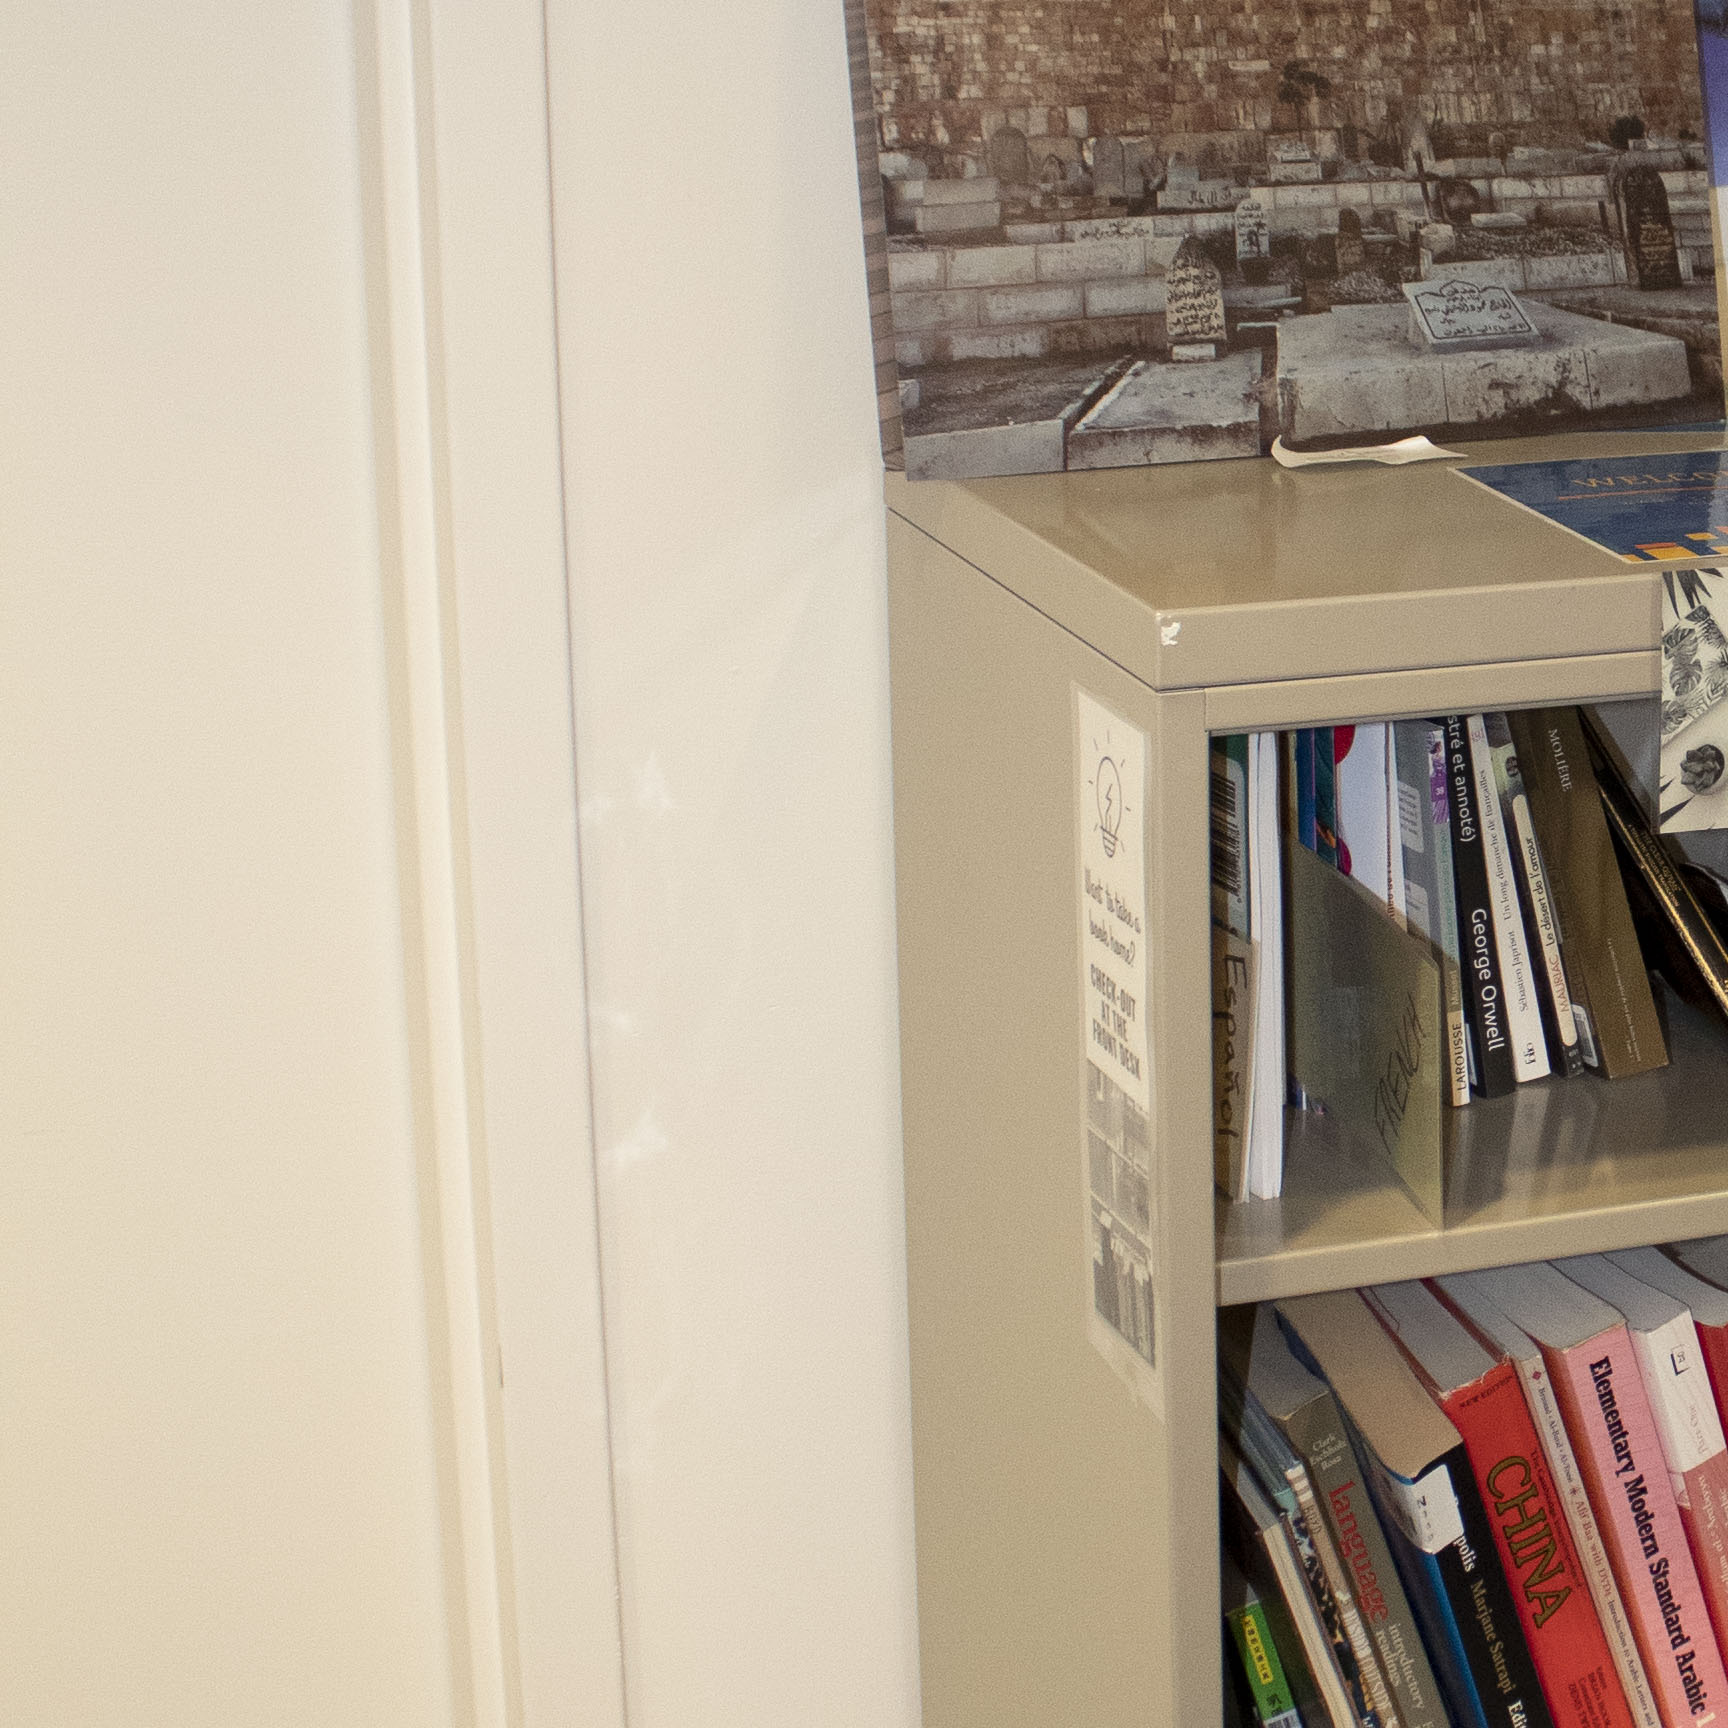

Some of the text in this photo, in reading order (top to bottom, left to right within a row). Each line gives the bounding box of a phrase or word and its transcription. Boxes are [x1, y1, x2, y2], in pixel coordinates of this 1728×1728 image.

[1487, 832, 1507, 880] dimanche
[1085, 866, 1133, 928] Want take
[1450, 753, 1503, 1051] et annoté) George Orwell
[1496, 881, 1511, 903] long
[1500, 905, 1513, 920] Un
[1089, 908, 1110, 948] book
[1504, 928, 1523, 968] Japrisot
[1522, 835, 1570, 1013] MAURIAC Le désert de l'amour
[1090, 962, 1136, 1021] CHECK-OUT
[1511, 968, 1530, 1012] Sébastien
[1092, 1016, 1141, 1081] FRONT DESK
[1112, 1009, 1127, 1041] THE
[1207, 953, 1249, 1137] Español
[1450, 1022, 1469, 1090] LAROUSSE
[1528, 1449, 1559, 1517] The Cambridge
[1574, 1498, 1589, 1519] Alif
[1581, 1521, 1595, 1542] Baa
[1481, 1449, 1578, 1631] CHINA
[1587, 1356, 1711, 1715] Elementary Modern Standard Arabic
[1588, 1543, 1603, 1565] with
[1320, 1480, 1427, 1712] language introductory
[1465, 1580, 1503, 1642] Marjane
[1486, 1641, 1518, 1694] Satrapi
[1605, 1599, 1630, 1647] Introduction
[1374, 1628, 1405, 1687] readings
[1625, 1657, 1642, 1683] Arabic
[1633, 1684, 1650, 1711] Letters
[1643, 1711, 1656, 1726] and
